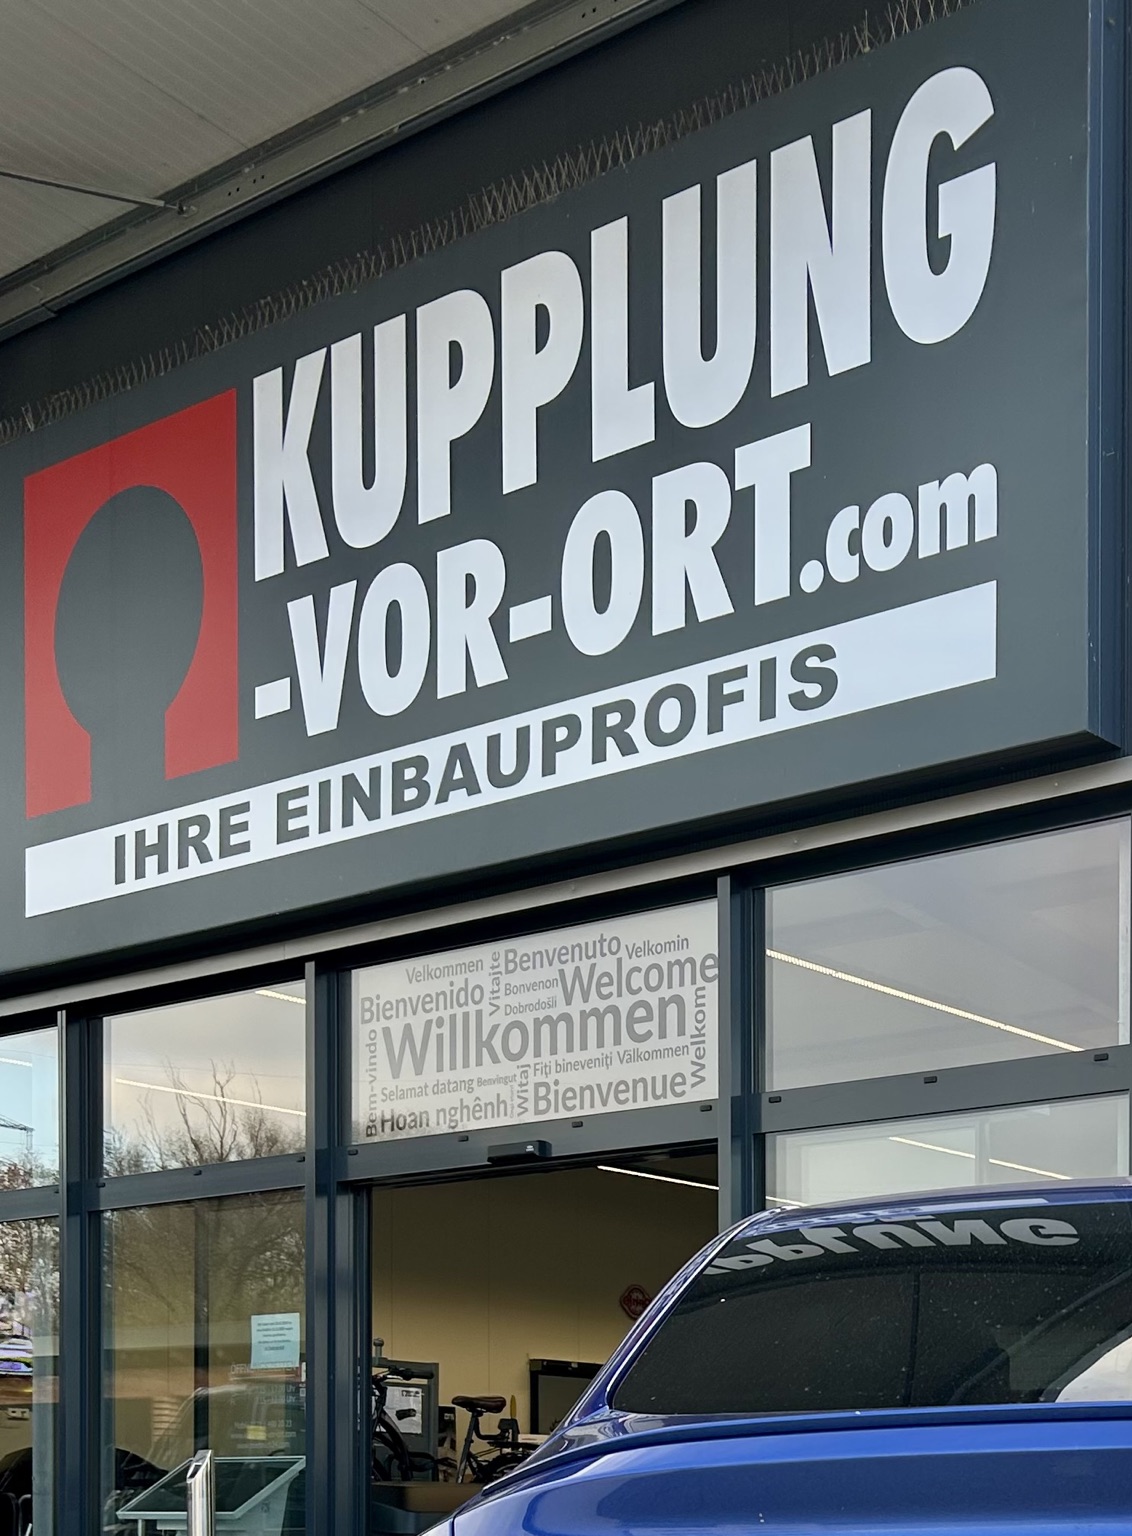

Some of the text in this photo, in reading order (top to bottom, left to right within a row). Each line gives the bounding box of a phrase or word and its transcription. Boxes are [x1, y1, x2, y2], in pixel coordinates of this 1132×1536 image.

[253, 66, 997, 582] KUPPLUNG
[254, 422, 998, 736] -VOR-ORT.com
[113, 642, 839, 885] IHRE EINBAUPROFIS
[504, 933, 621, 975] Benvenuto
[625, 934, 689, 960] Velkomin
[405, 958, 484, 984] Velkommen
[488, 951, 503, 1017] Vitajte
[504, 976, 559, 996] Bonvenon
[557, 952, 719, 1006] Welcome
[360, 977, 485, 1024] Bienvenido
[504, 995, 557, 1016] Dobrodošli
[381, 993, 686, 1080] Willkommen
[617, 1043, 689, 1065] Välkommen
[690, 986, 706, 1089] Welkom
[365, 1029, 378, 1138] Bem-vindo
[381, 1078, 475, 1103] Selamat datang
[517, 1064, 531, 1117] Witaj
[533, 1071, 687, 1116] Bienvenue
[381, 1093, 508, 1133] Hoan nghênh
